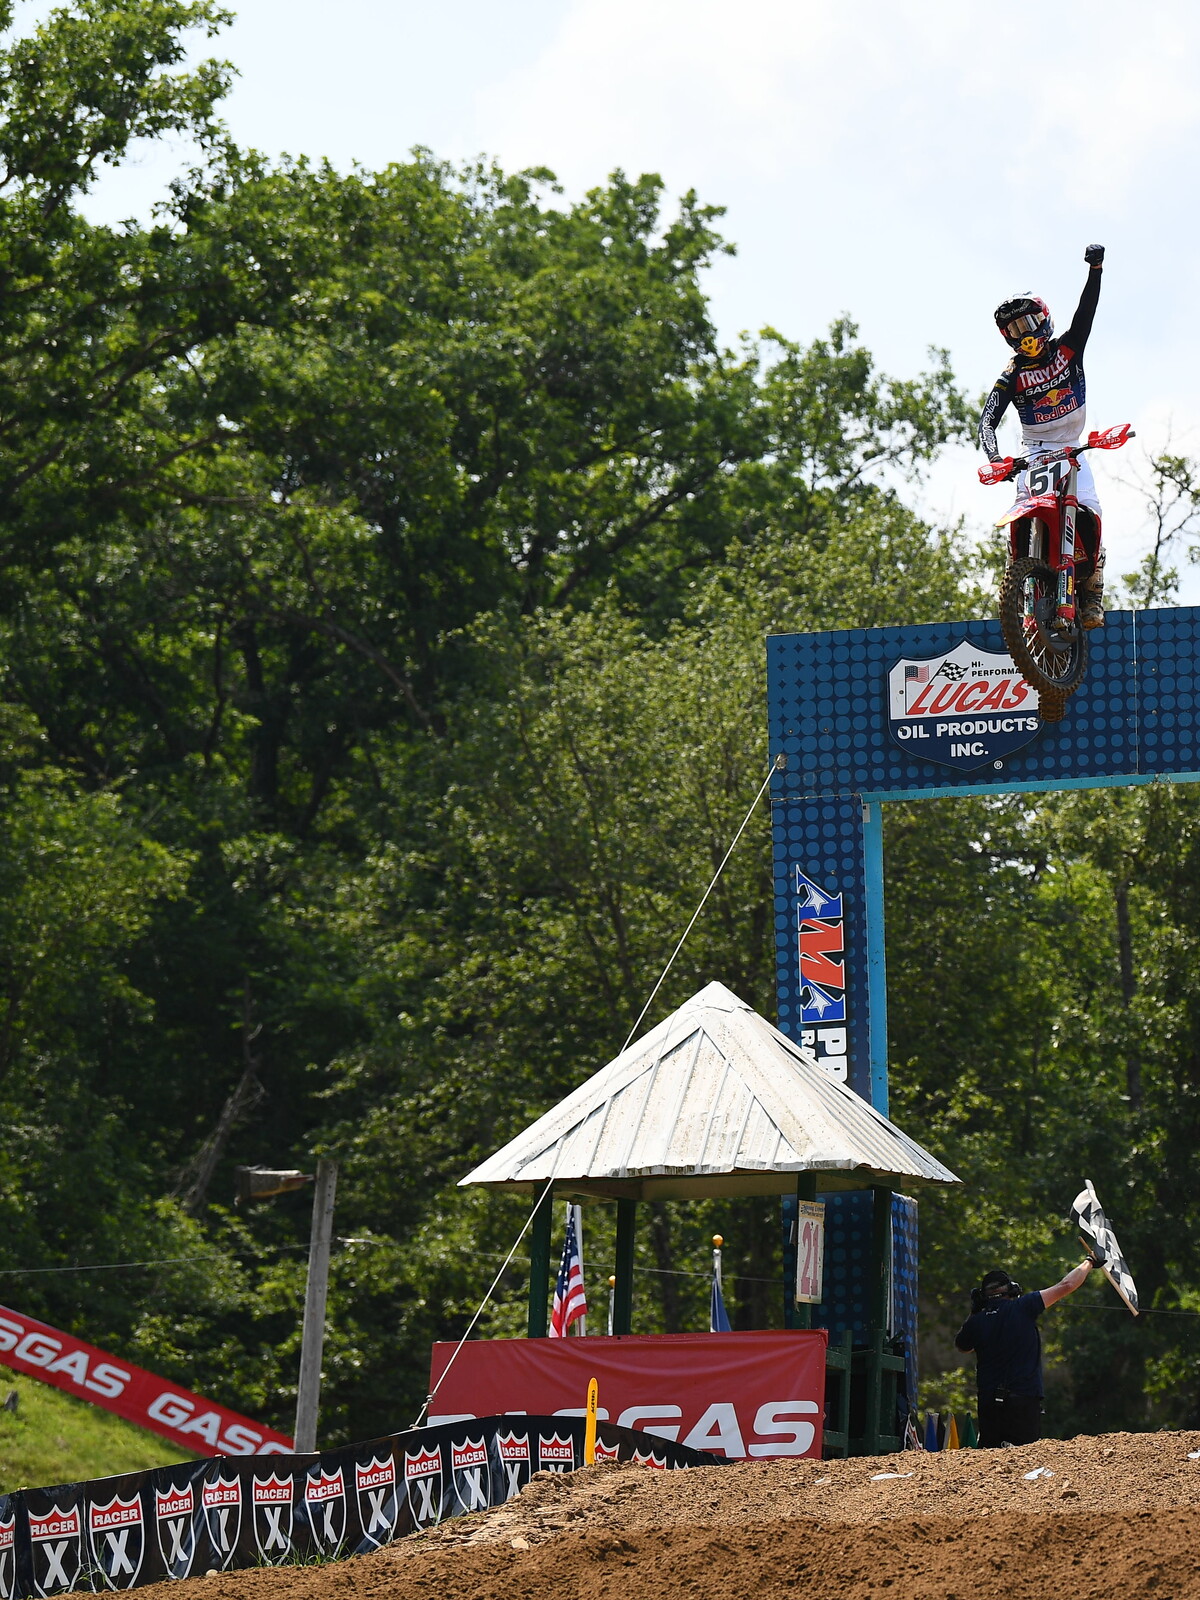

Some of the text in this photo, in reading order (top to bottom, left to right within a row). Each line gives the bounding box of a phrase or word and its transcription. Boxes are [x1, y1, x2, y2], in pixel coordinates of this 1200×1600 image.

[1019, 366, 1051, 388] TROY
[1050, 349, 1069, 376] LEE
[1025, 367, 1071, 396] GASGAS
[1034, 396, 1078, 423] Red Bull
[1029, 462, 1062, 496] 51
[971, 667, 1020, 678] PERFORMA
[906, 679, 1030, 716] LUCAS
[897, 717, 1039, 740] OIL PRODUCTS
[951, 742, 989, 758] INC.
[817, 1027, 848, 1084] PR
[801, 1221, 819, 1296] 21
[147, 1392, 294, 1455] GAS
[407, 1459, 439, 1475] RACER
[454, 1450, 485, 1465] RACER
[541, 1447, 571, 1458] RACER
[255, 1488, 290, 1500] RACER
[358, 1470, 393, 1487] RACER
[463, 1467, 488, 1510] X
[505, 1463, 521, 1500] X
[158, 1498, 191, 1515] RACER
[204, 1489, 238, 1504] RACER
[368, 1488, 392, 1534] X
[416, 1477, 436, 1522] X
[31, 1519, 76, 1536] RACER
[93, 1508, 139, 1526] RACER
[264, 1506, 286, 1550] X
[105, 1529, 135, 1577] X
[167, 1517, 189, 1565] X
[42, 1540, 70, 1589] X
